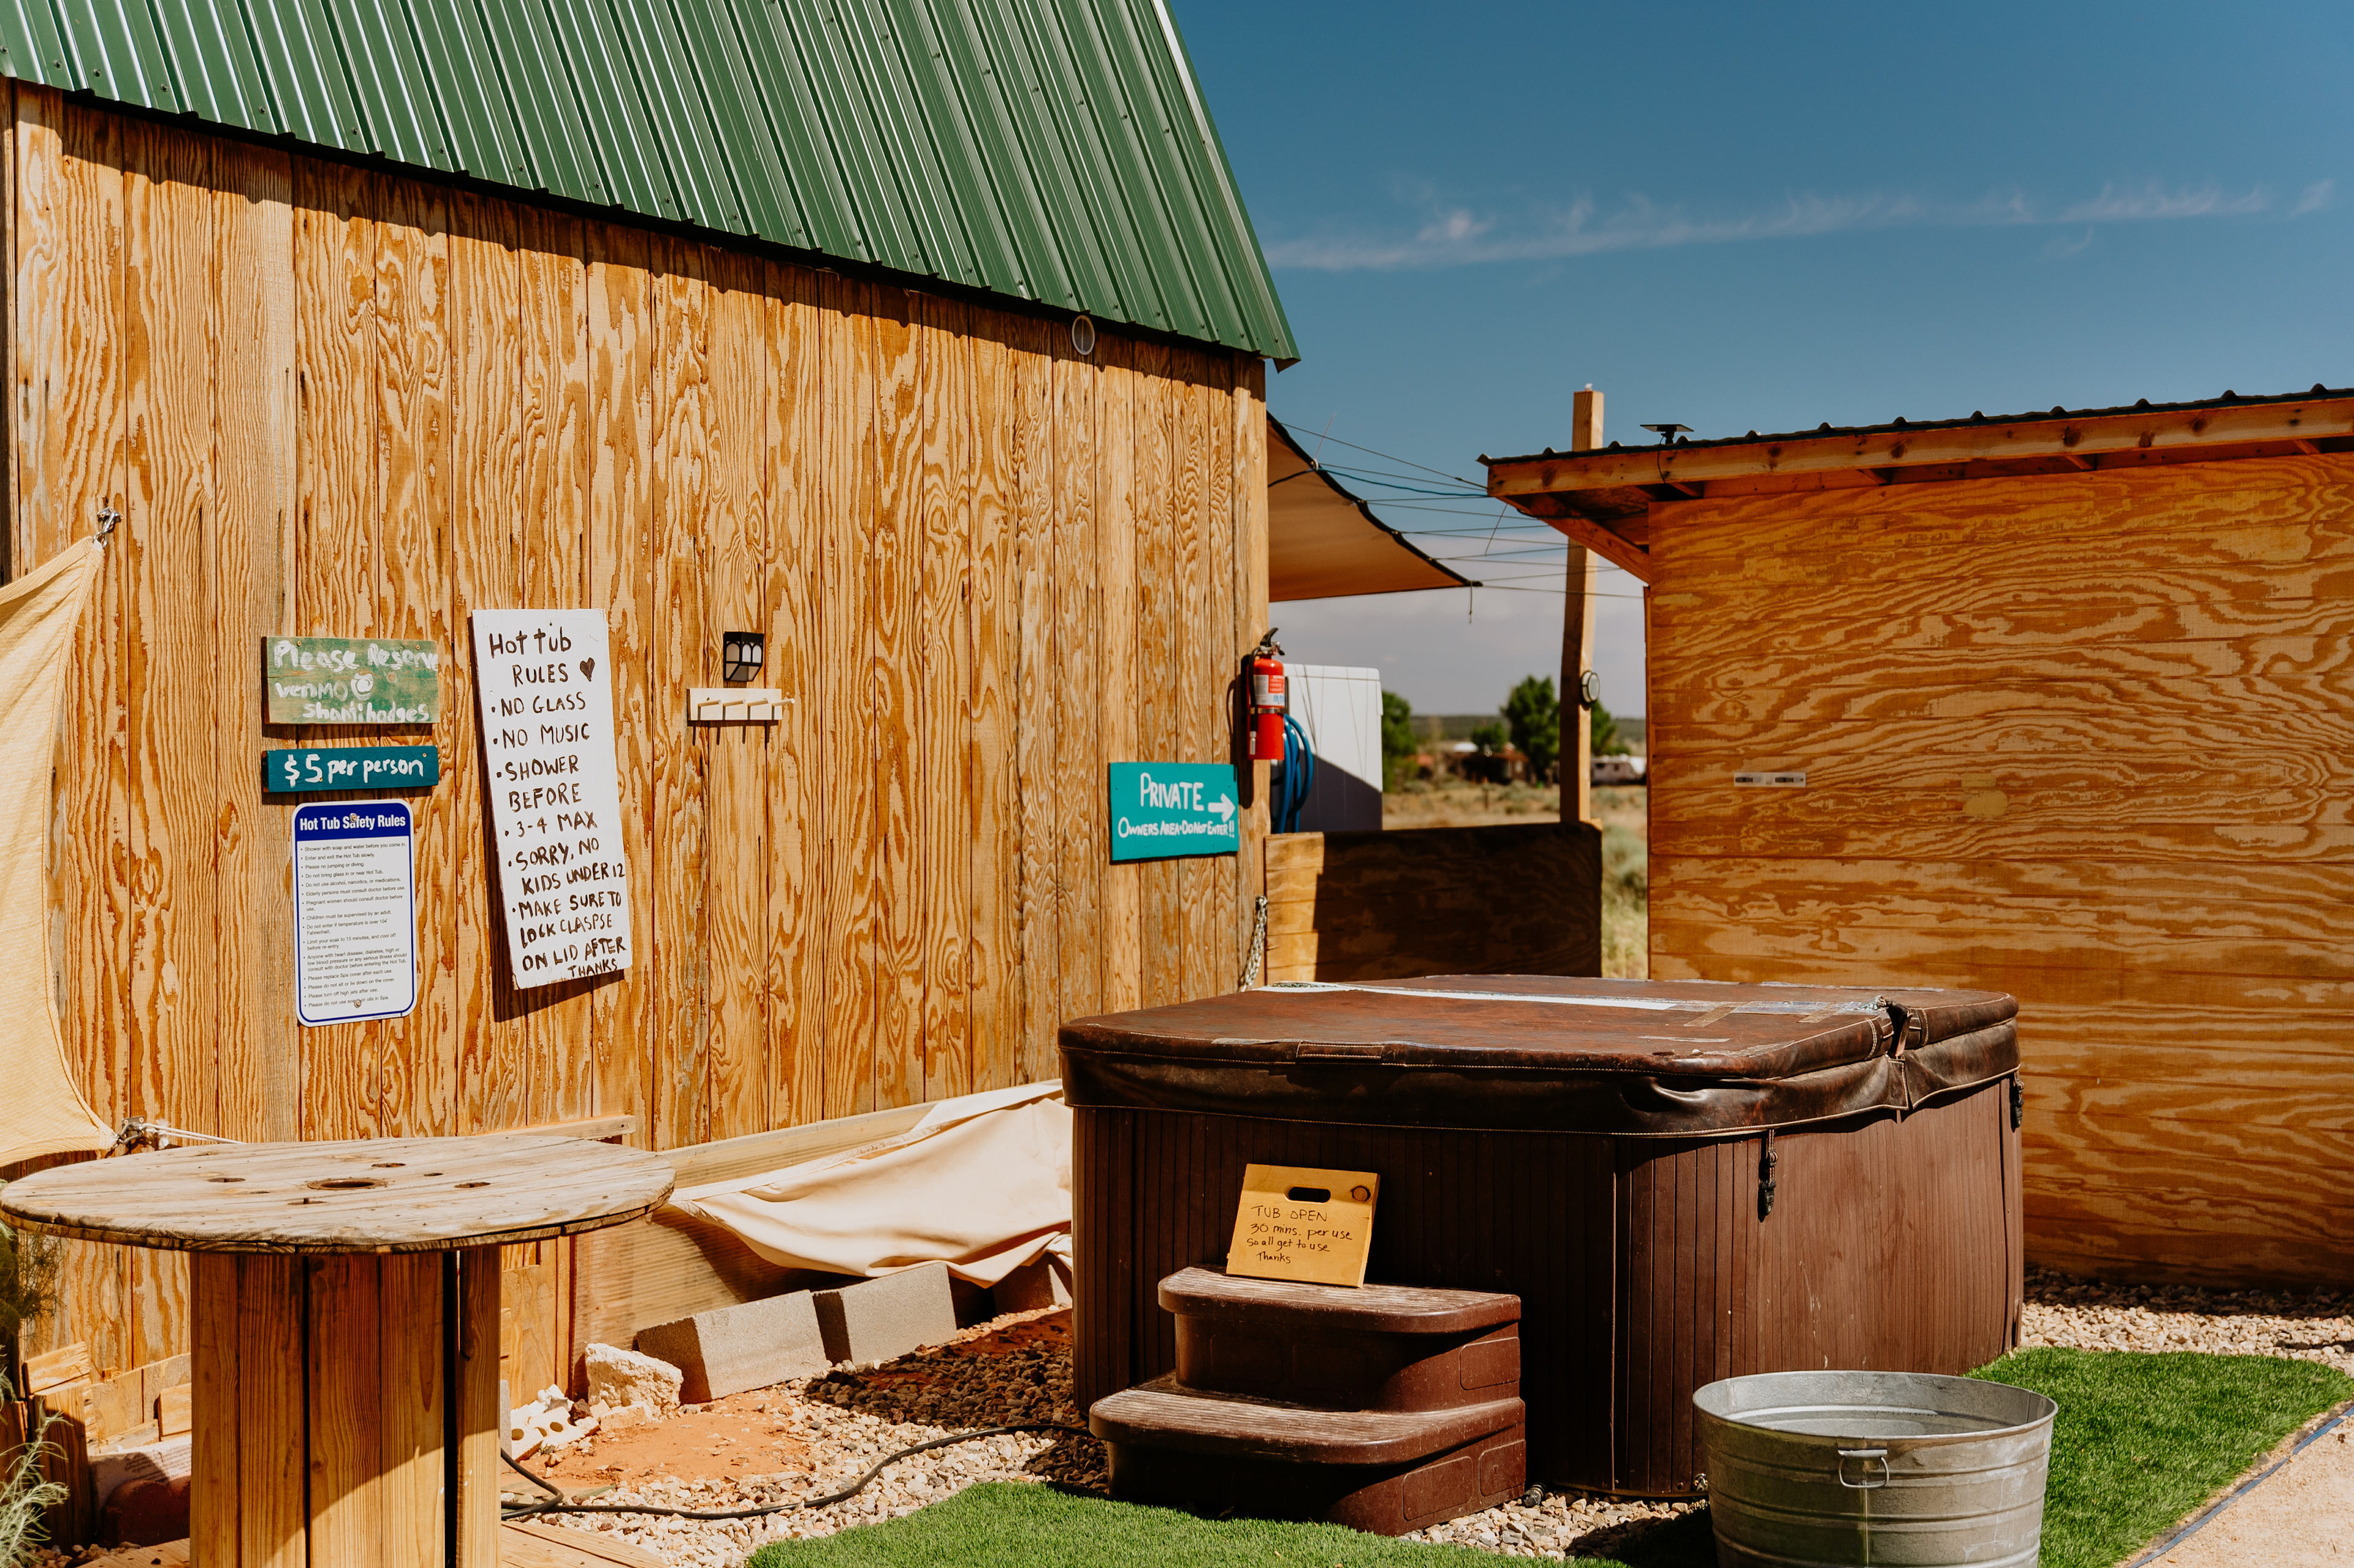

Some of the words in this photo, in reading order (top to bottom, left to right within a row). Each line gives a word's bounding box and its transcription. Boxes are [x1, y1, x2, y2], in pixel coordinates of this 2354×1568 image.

[275, 640, 360, 672] Please
[489, 630, 528, 659] Hot
[512, 663, 568, 687] RULES
[501, 698, 524, 717] NO
[533, 691, 586, 714] GLASS
[502, 728, 528, 750] NO
[540, 722, 590, 745] MUSIC
[327, 759, 358, 784] per
[363, 759, 424, 783] person
[505, 755, 579, 781] SHOWER
[509, 783, 582, 813] BEFORE
[1140, 772, 1205, 811] PRIVATE
[300, 818, 318, 831] Hot
[320, 816, 340, 830] Tub
[343, 815, 375, 830] Safety
[378, 814, 406, 828] Rules
[517, 816, 547, 838] 3-4
[557, 810, 598, 832] MAX
[1118, 816, 1159, 838] OWNERS
[516, 842, 574, 871] SORRY,
[579, 837, 600, 856] NO
[522, 873, 561, 896] KIDS
[566, 862, 609, 885] UNDER
[612, 862, 625, 878] 12
[518, 899, 562, 920] MAKE
[569, 891, 604, 910] SURE
[607, 891, 621, 907] TO
[520, 923, 557, 949] LOCK
[560, 913, 612, 934] CLASPSE
[522, 952, 548, 971] ON
[553, 945, 579, 965] LID
[584, 936, 627, 961] AFTER
[567, 958, 618, 978] THANKS
[1251, 1205, 1281, 1219] TUB
[1290, 1209, 1328, 1222] OPEN
[1250, 1223, 1268, 1235] 30
[1273, 1224, 1301, 1236] mins.
[1307, 1228, 1330, 1241] per
[1332, 1229, 1353, 1241] use
[1262, 1236, 1273, 1246] all
[1277, 1239, 1293, 1252] get
[1296, 1239, 1306, 1249] to
[1309, 1242, 1330, 1252] use
[1256, 1251, 1291, 1264] Thanks
